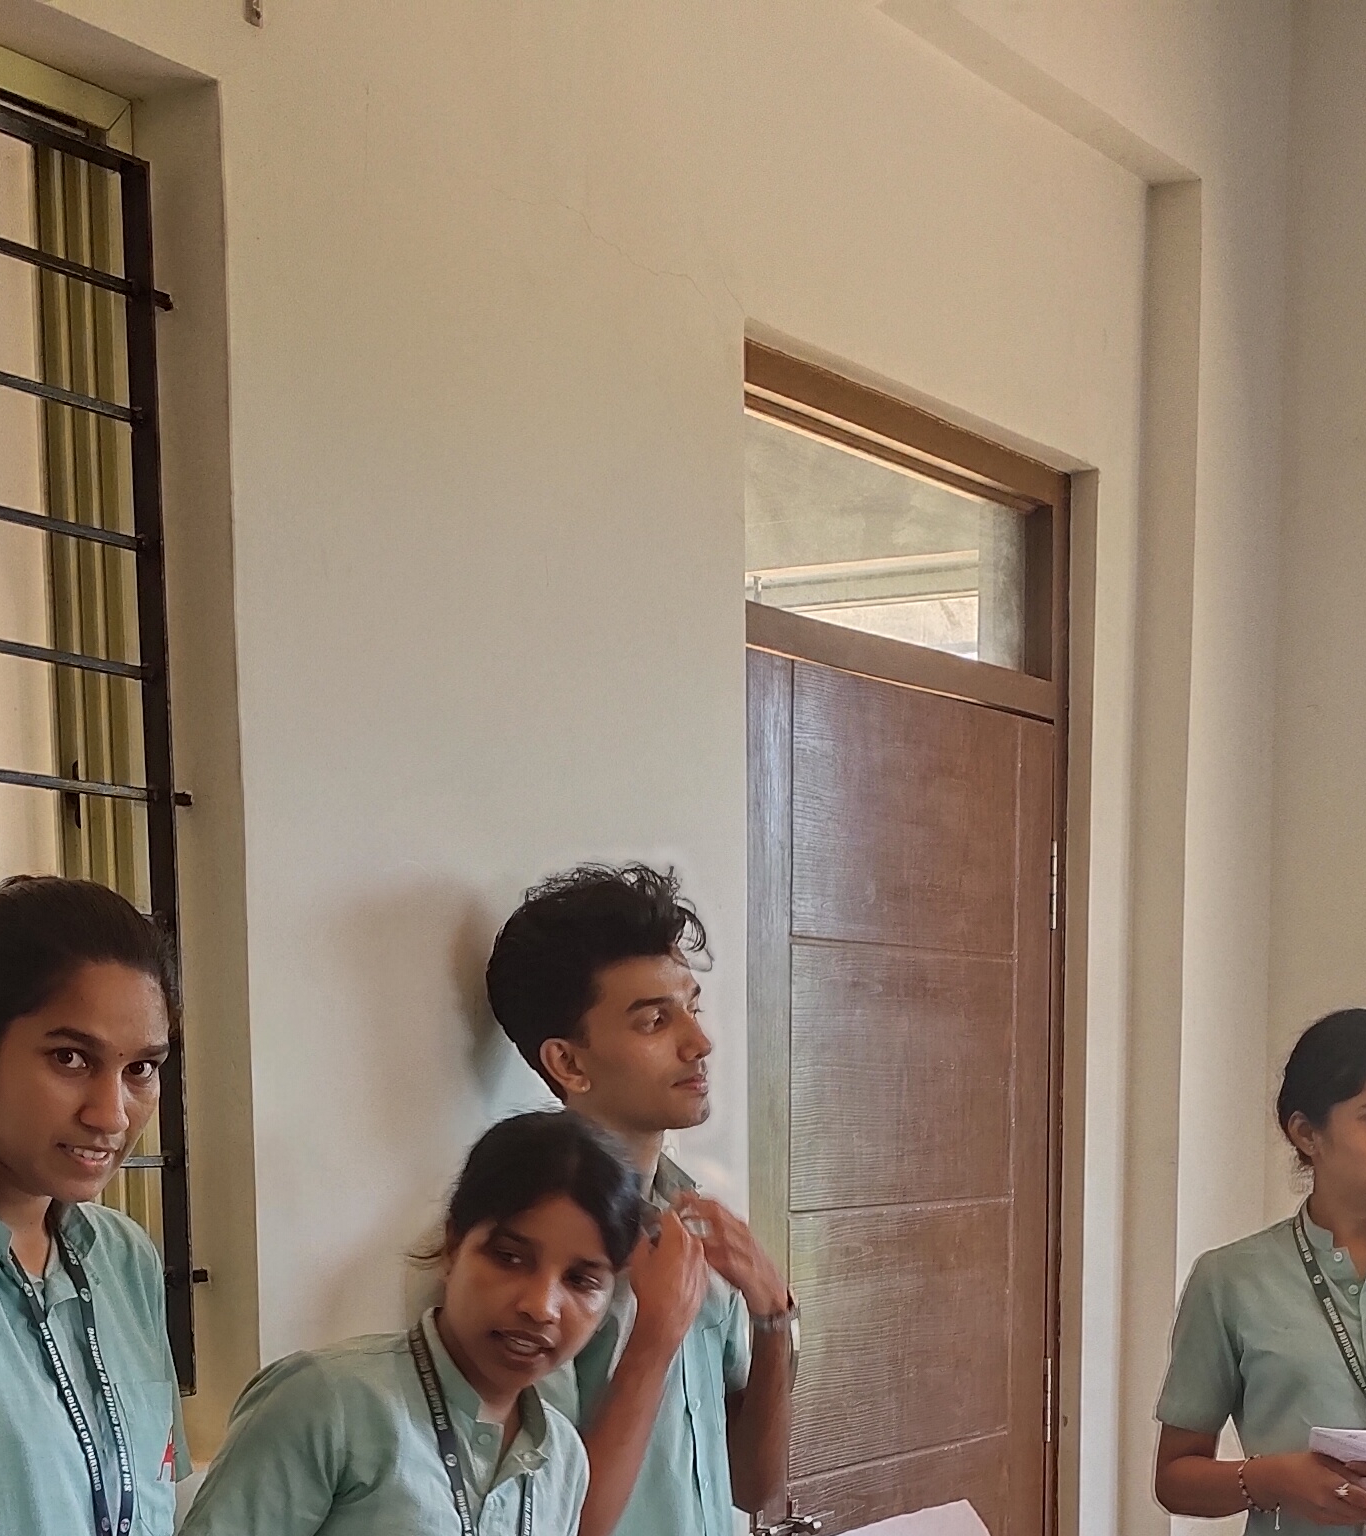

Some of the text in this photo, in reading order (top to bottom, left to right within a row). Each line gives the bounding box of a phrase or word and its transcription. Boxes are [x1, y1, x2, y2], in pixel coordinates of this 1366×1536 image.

[46, 1341, 69, 1389] ADARSHA
[87, 1326, 105, 1370] NURSING
[64, 1389, 87, 1430] COLLEGE
[81, 1431, 92, 1444] OF
[114, 1426, 130, 1475] ADARSHA
[85, 1444, 102, 1491] NURSING
[123, 1475, 132, 1492] SRI
